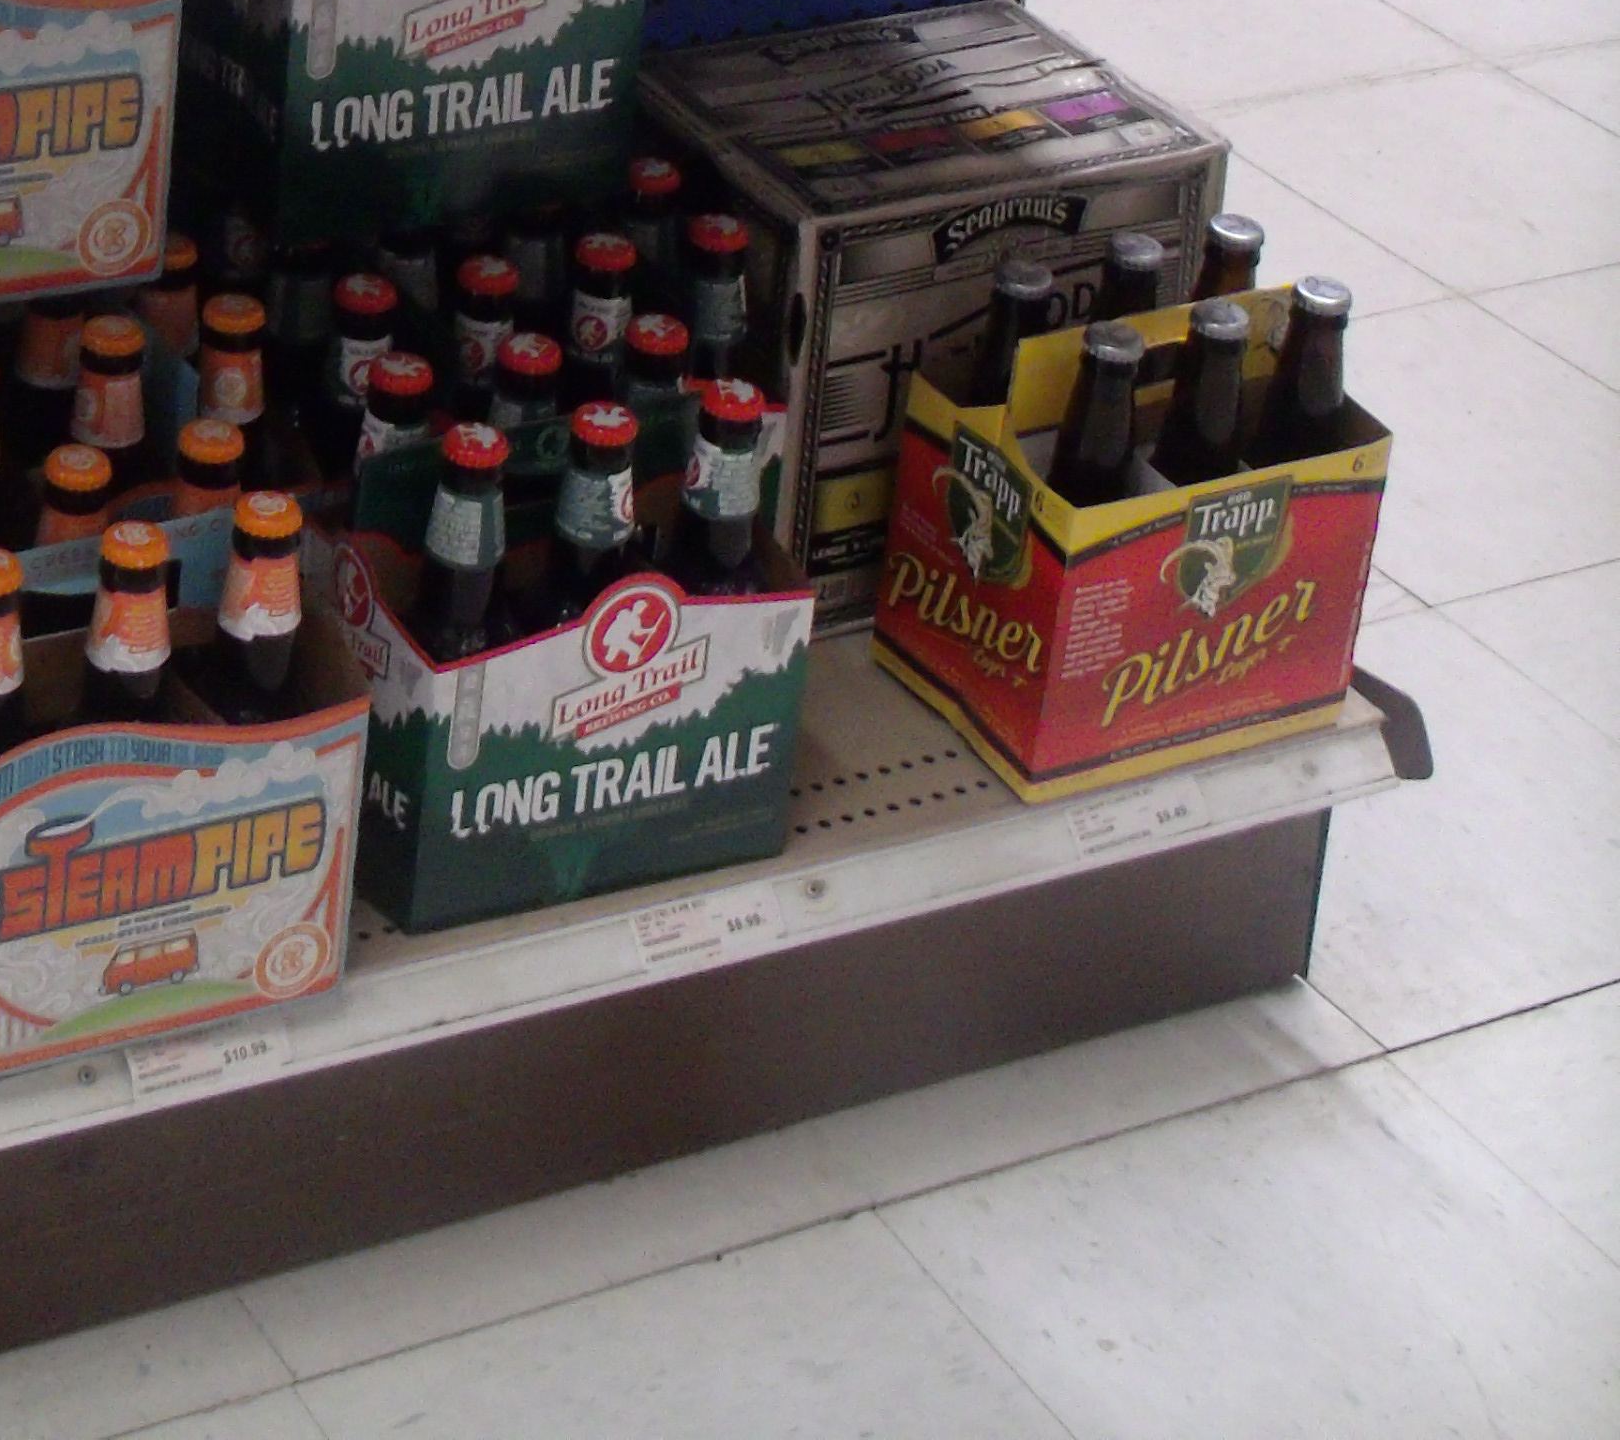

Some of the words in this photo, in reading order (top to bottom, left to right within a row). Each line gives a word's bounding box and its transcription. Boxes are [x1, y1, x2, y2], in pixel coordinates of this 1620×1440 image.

[408, 4, 473, 43] Long
[312, 90, 414, 151] LONG
[423, 72, 532, 134] TRAIL
[541, 59, 616, 116] ALE
[959, 436, 1021, 521] Trapp
[1194, 497, 1276, 538] Trapp
[889, 551, 1043, 673] Pilsner
[1102, 581, 1316, 727] Pilsner
[558, 688, 627, 726] Long
[633, 657, 699, 696] Trail
[52, 738, 105, 772] STASH
[130, 739, 168, 764] YOUR
[451, 771, 561, 839] LONG
[570, 744, 687, 814] TRAIL
[694, 723, 775, 787] ALE
